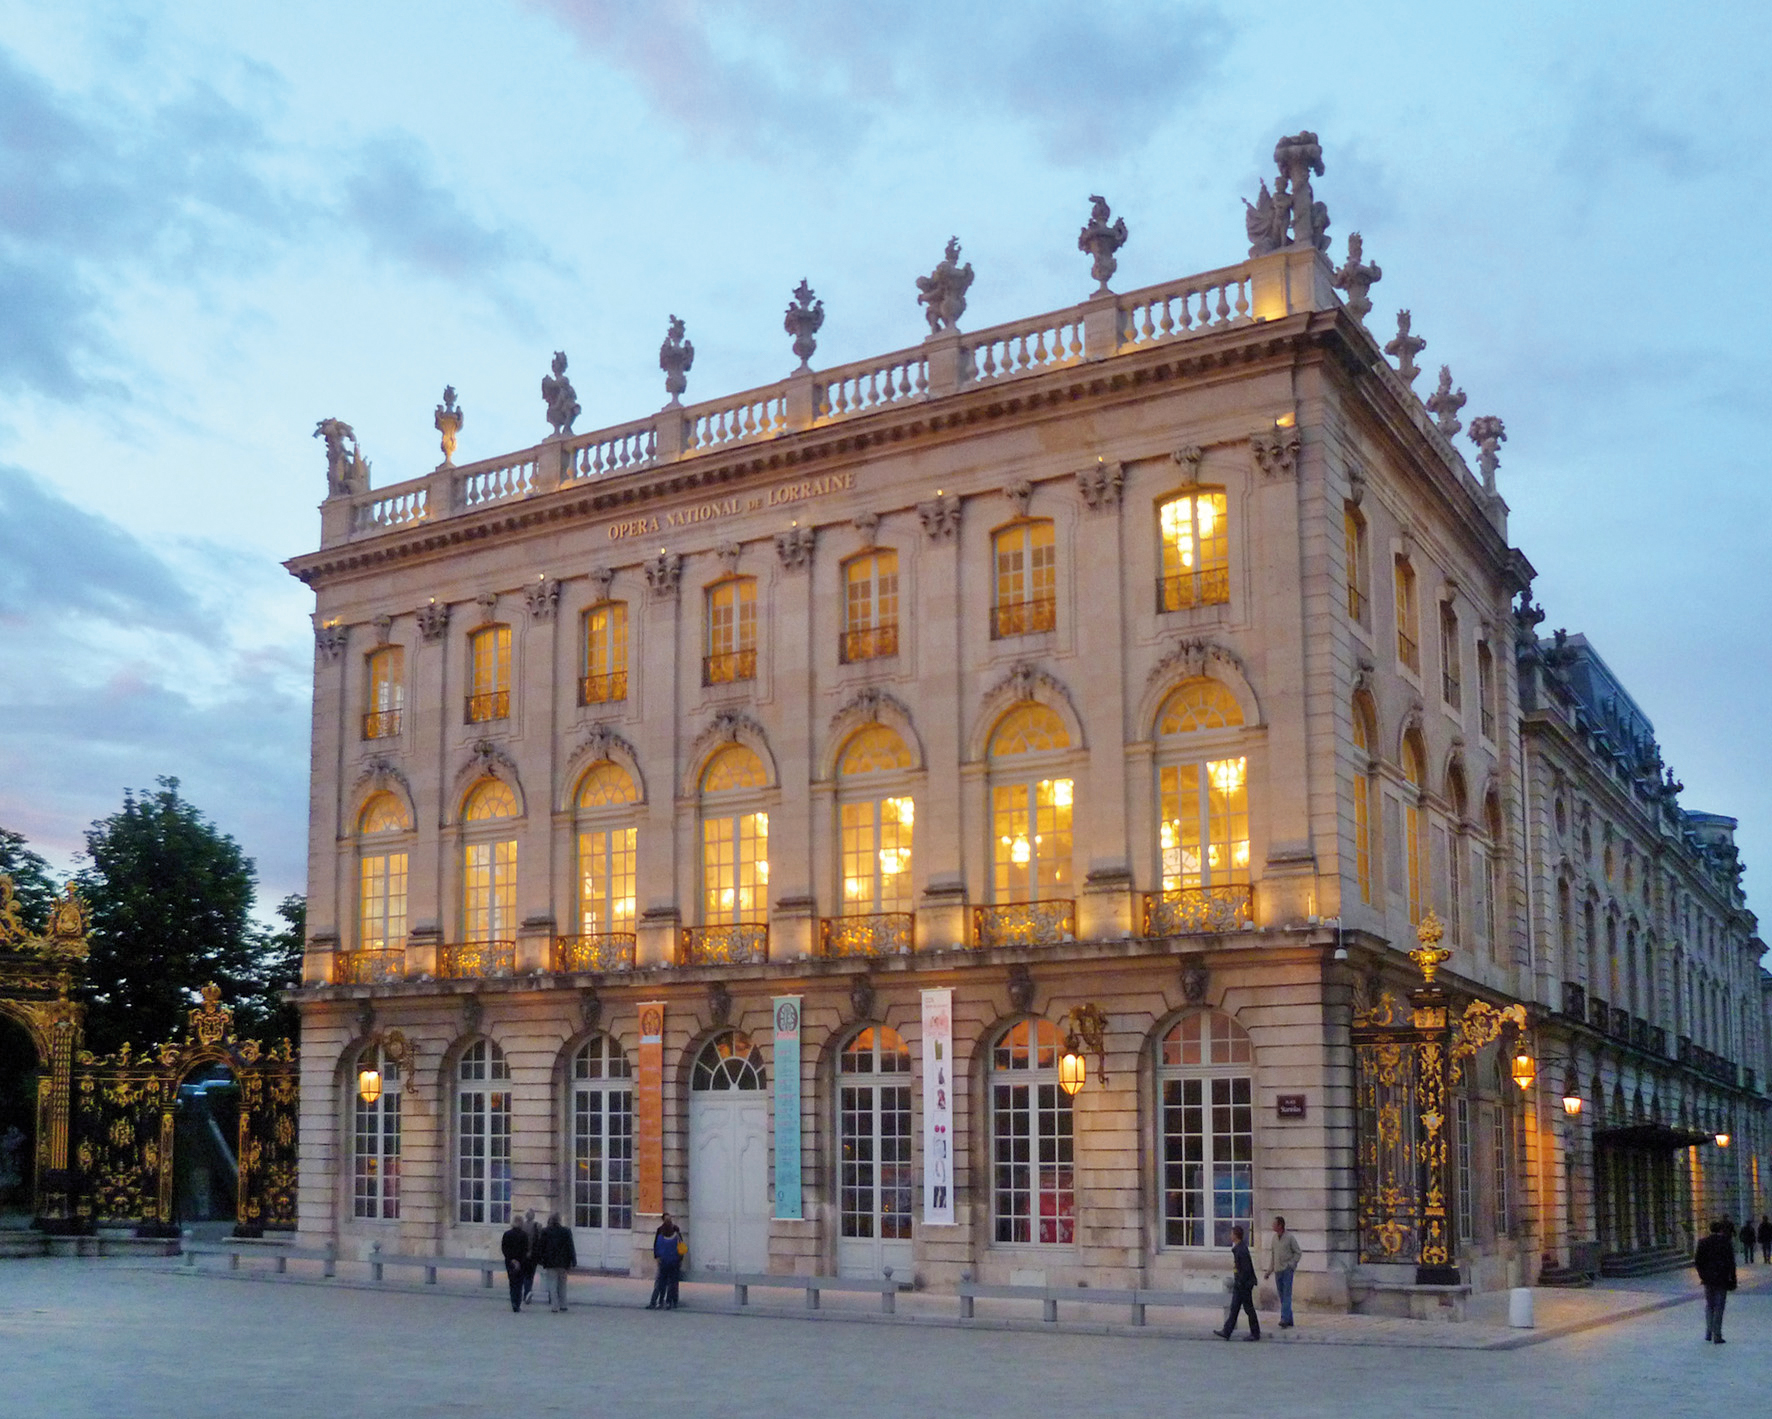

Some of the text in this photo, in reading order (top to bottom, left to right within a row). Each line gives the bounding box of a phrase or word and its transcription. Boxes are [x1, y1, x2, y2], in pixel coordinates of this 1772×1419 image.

[608, 516, 660, 540] OPERA
[667, 498, 742, 527] NATIONAL
[769, 473, 857, 506] LORRAINE
